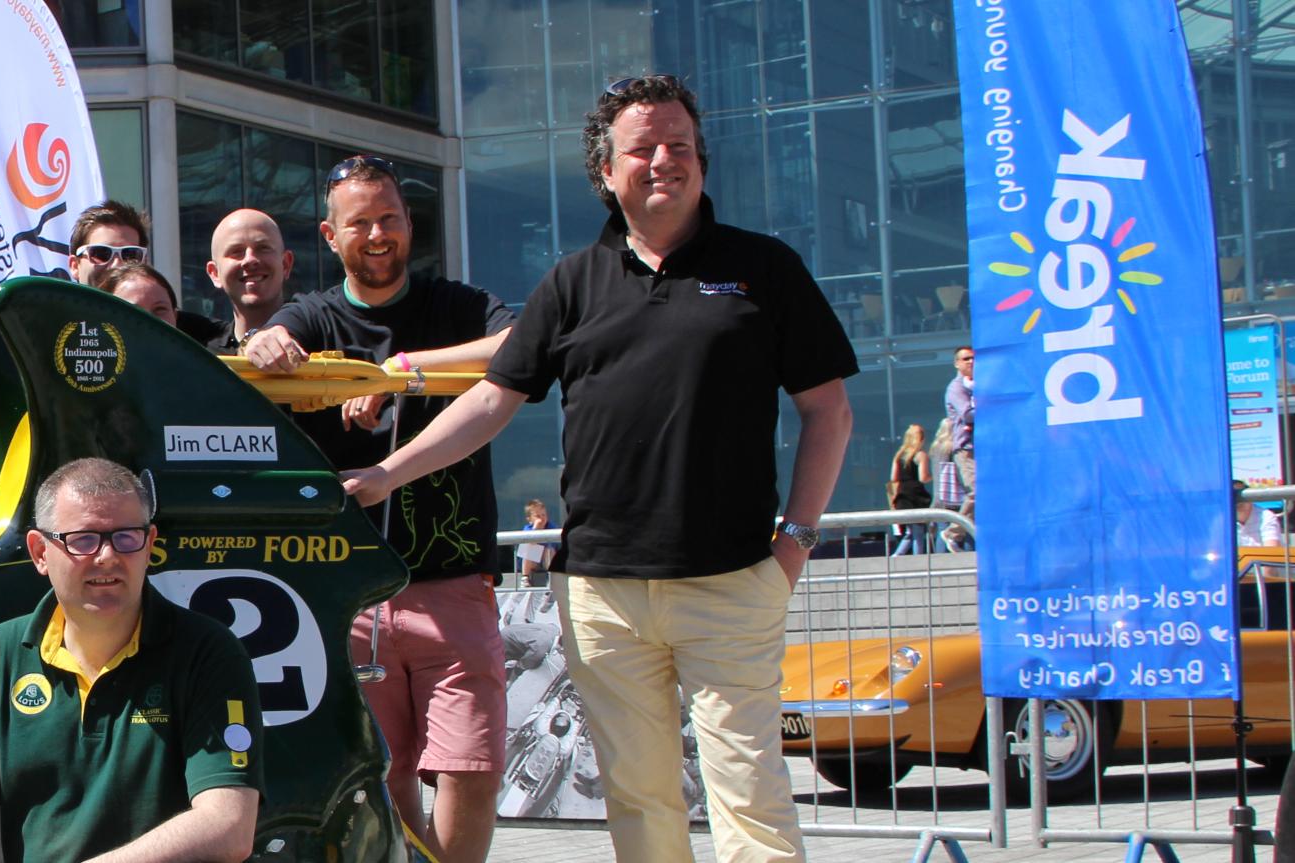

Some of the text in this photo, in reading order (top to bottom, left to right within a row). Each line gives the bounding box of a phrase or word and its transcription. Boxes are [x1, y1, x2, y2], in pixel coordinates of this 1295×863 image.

[79, 321, 99, 337] 1st
[80, 339, 100, 347] 1965
[65, 348, 118, 359] Indianapolis
[75, 359, 104, 374] 500
[167, 434, 276, 453] Jim CLARK
[178, 536, 257, 549] POWERED
[263, 535, 350, 563] FORD
[206, 550, 228, 563] BY
[18, 695, 46, 706] LOTUS
